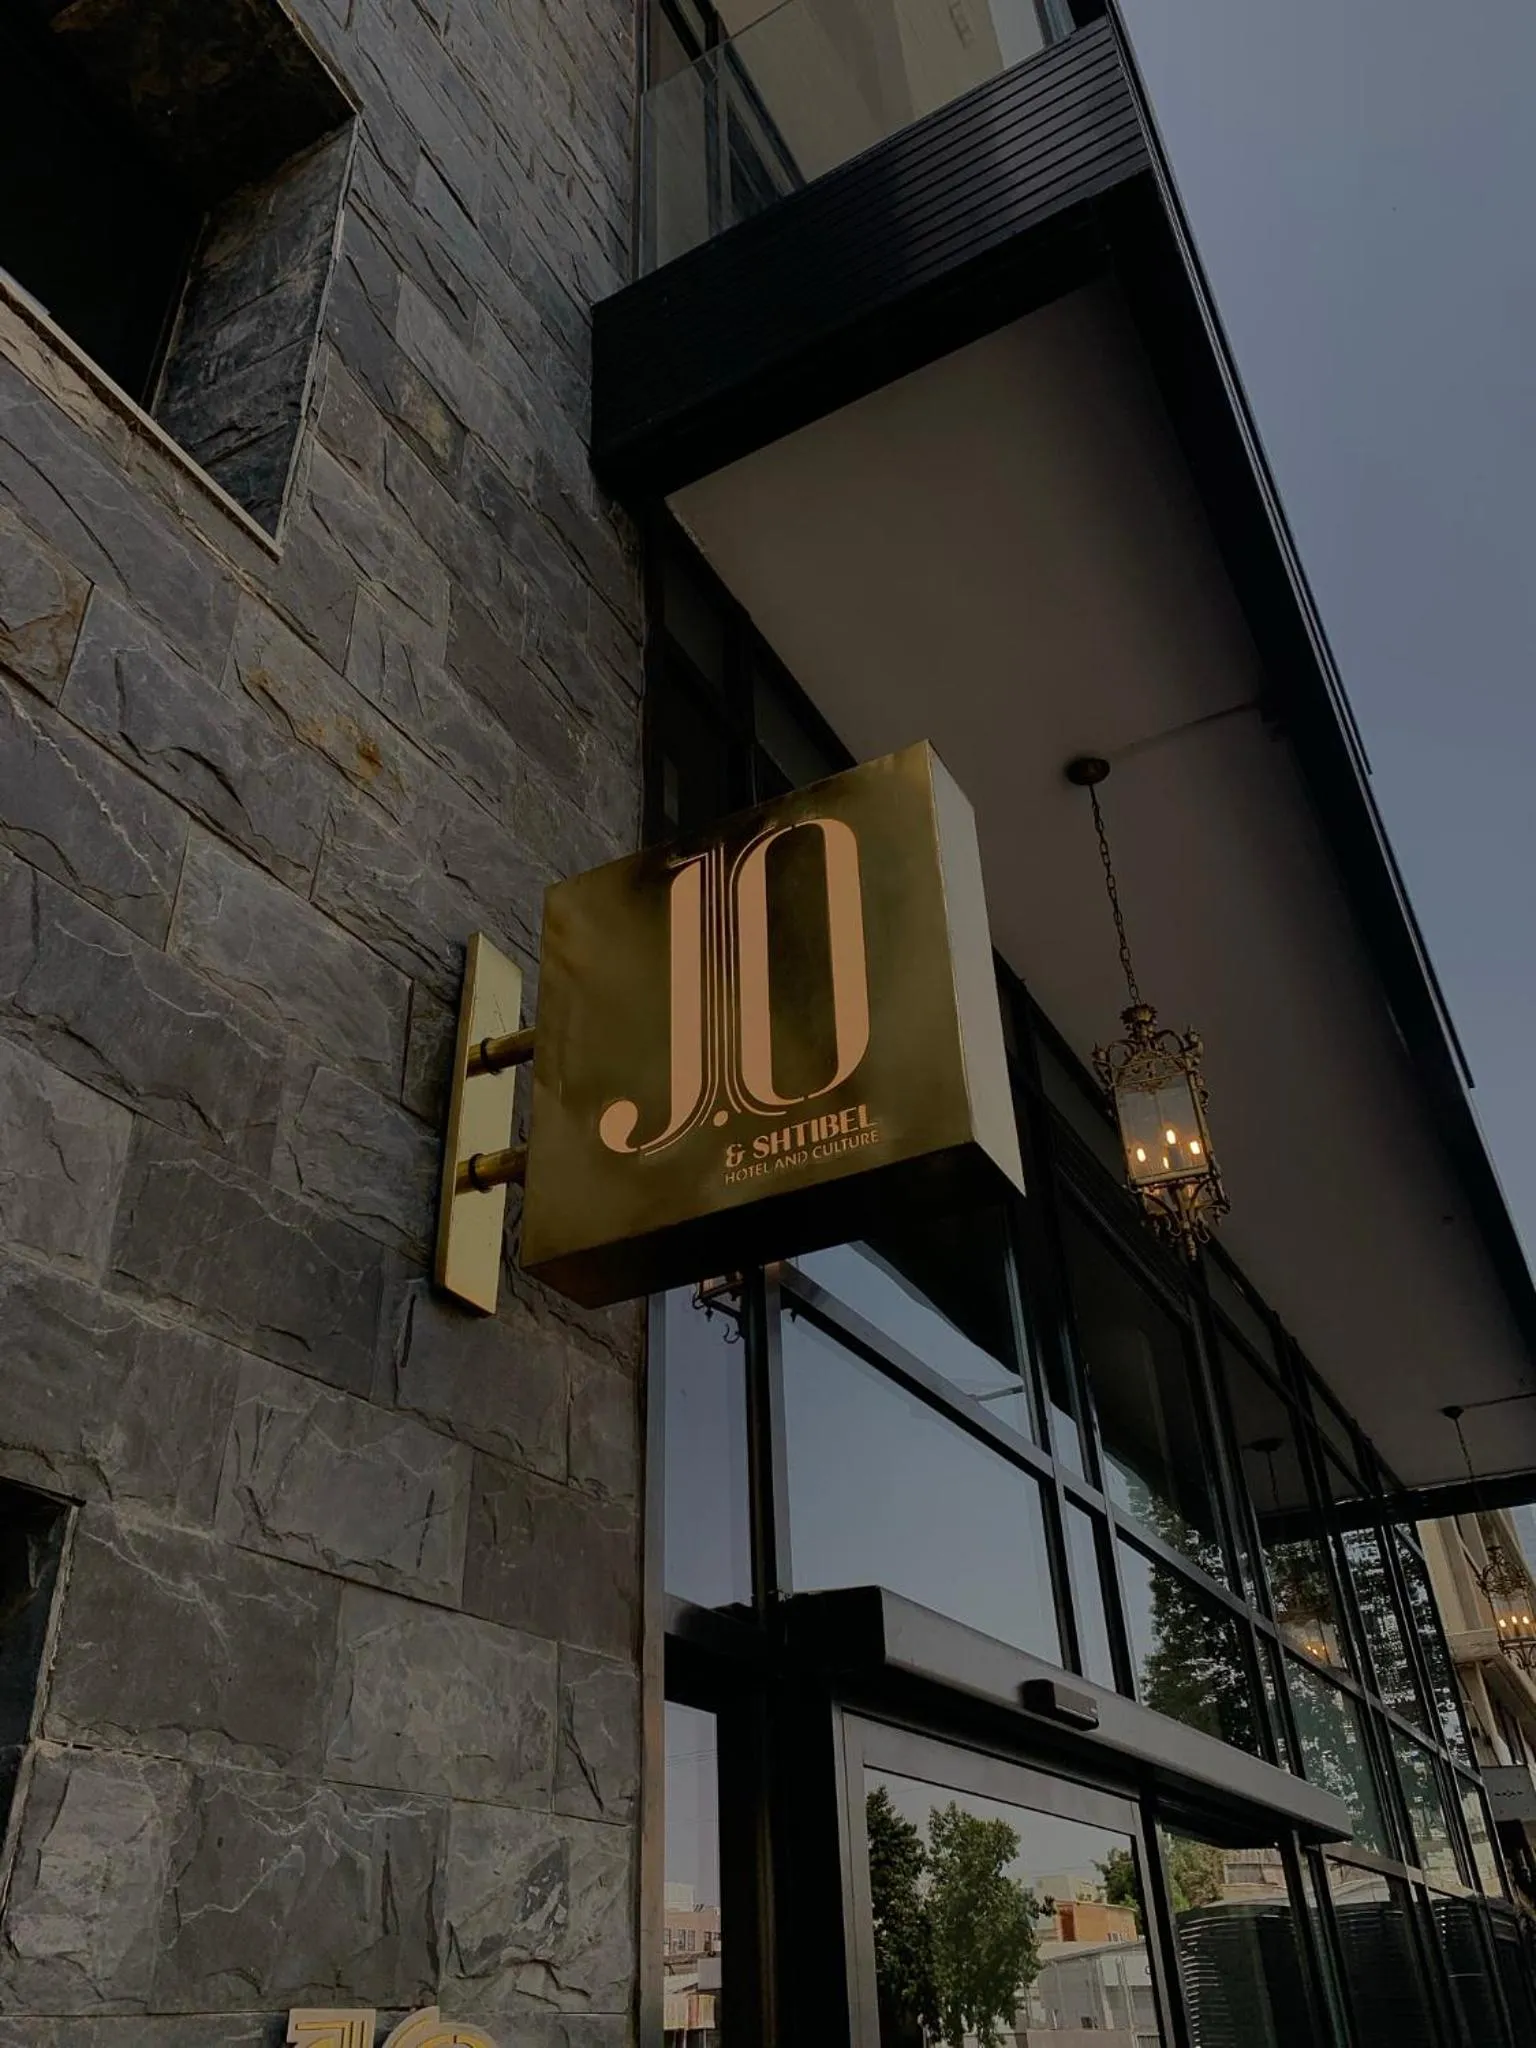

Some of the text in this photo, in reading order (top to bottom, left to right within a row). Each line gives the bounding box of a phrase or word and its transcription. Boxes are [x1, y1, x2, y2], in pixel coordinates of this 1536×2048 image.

[724, 1129, 880, 1185] HOTEL AND CULTURE
[725, 1104, 880, 1168] & SHTIBEL
